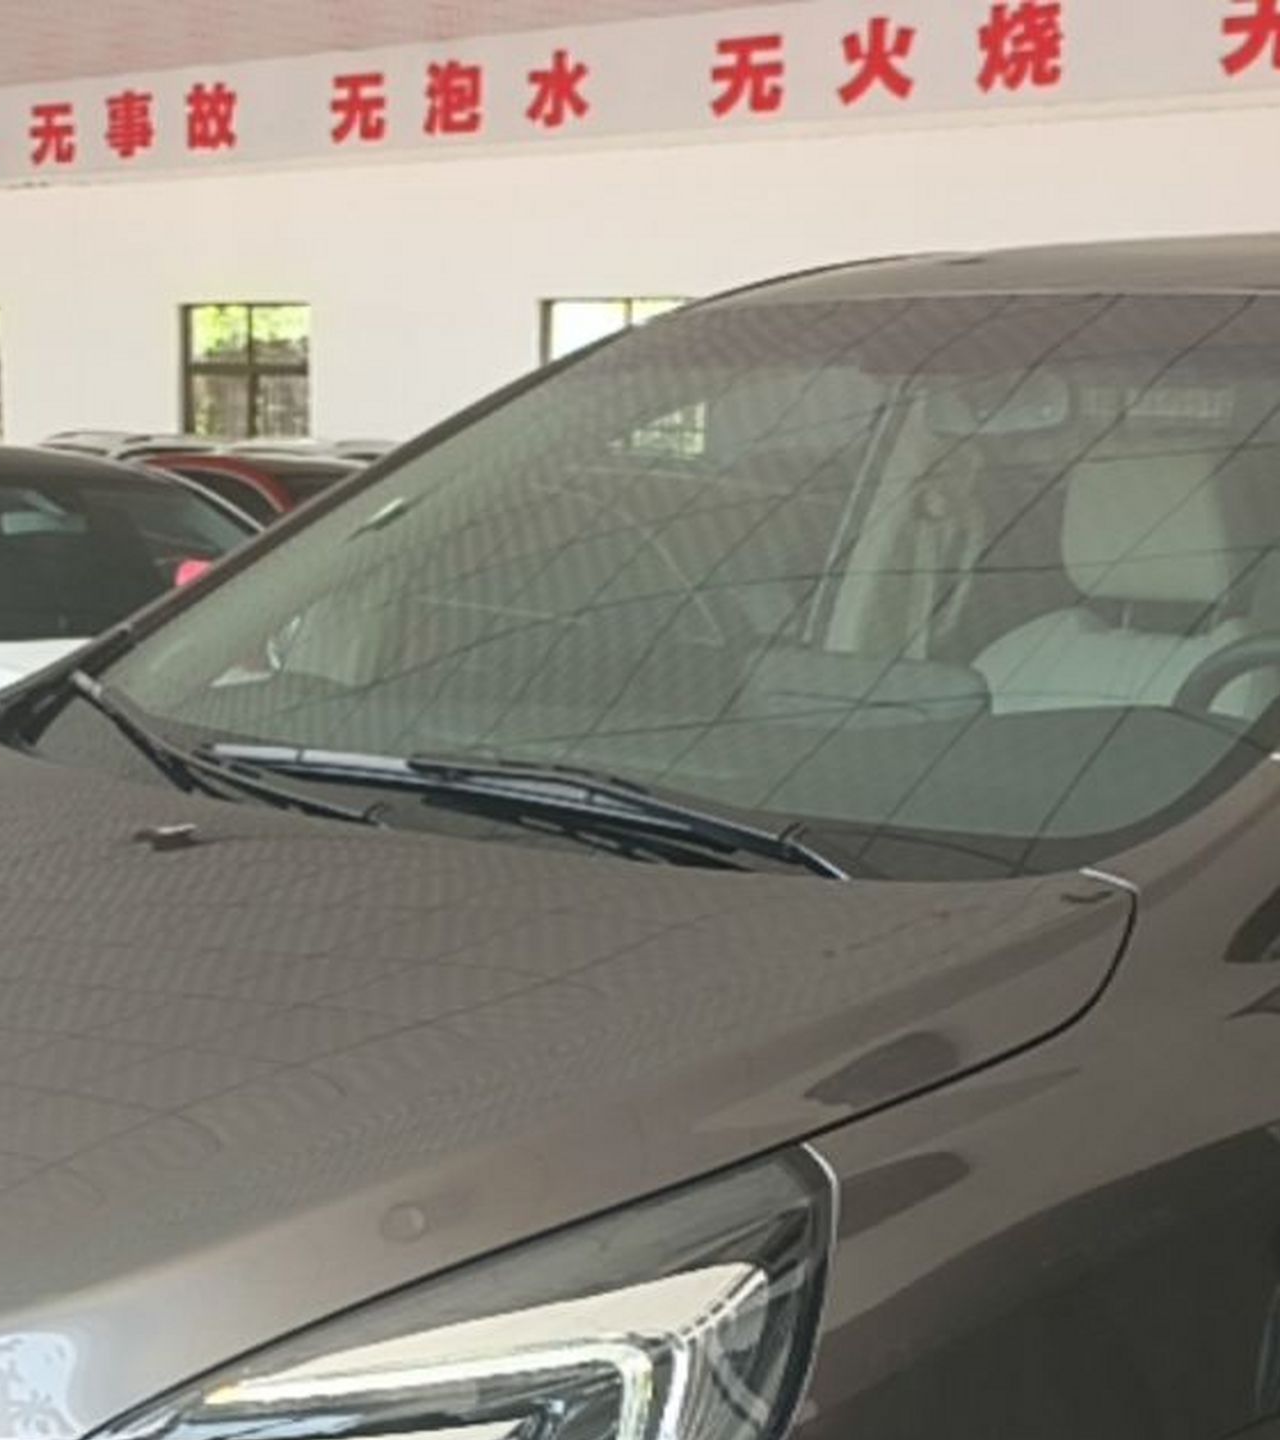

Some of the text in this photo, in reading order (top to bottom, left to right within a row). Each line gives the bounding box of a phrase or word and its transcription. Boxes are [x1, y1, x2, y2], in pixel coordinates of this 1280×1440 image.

[329, 48, 591, 145] 无泡水
[709, 0, 1066, 121] 无火烧
